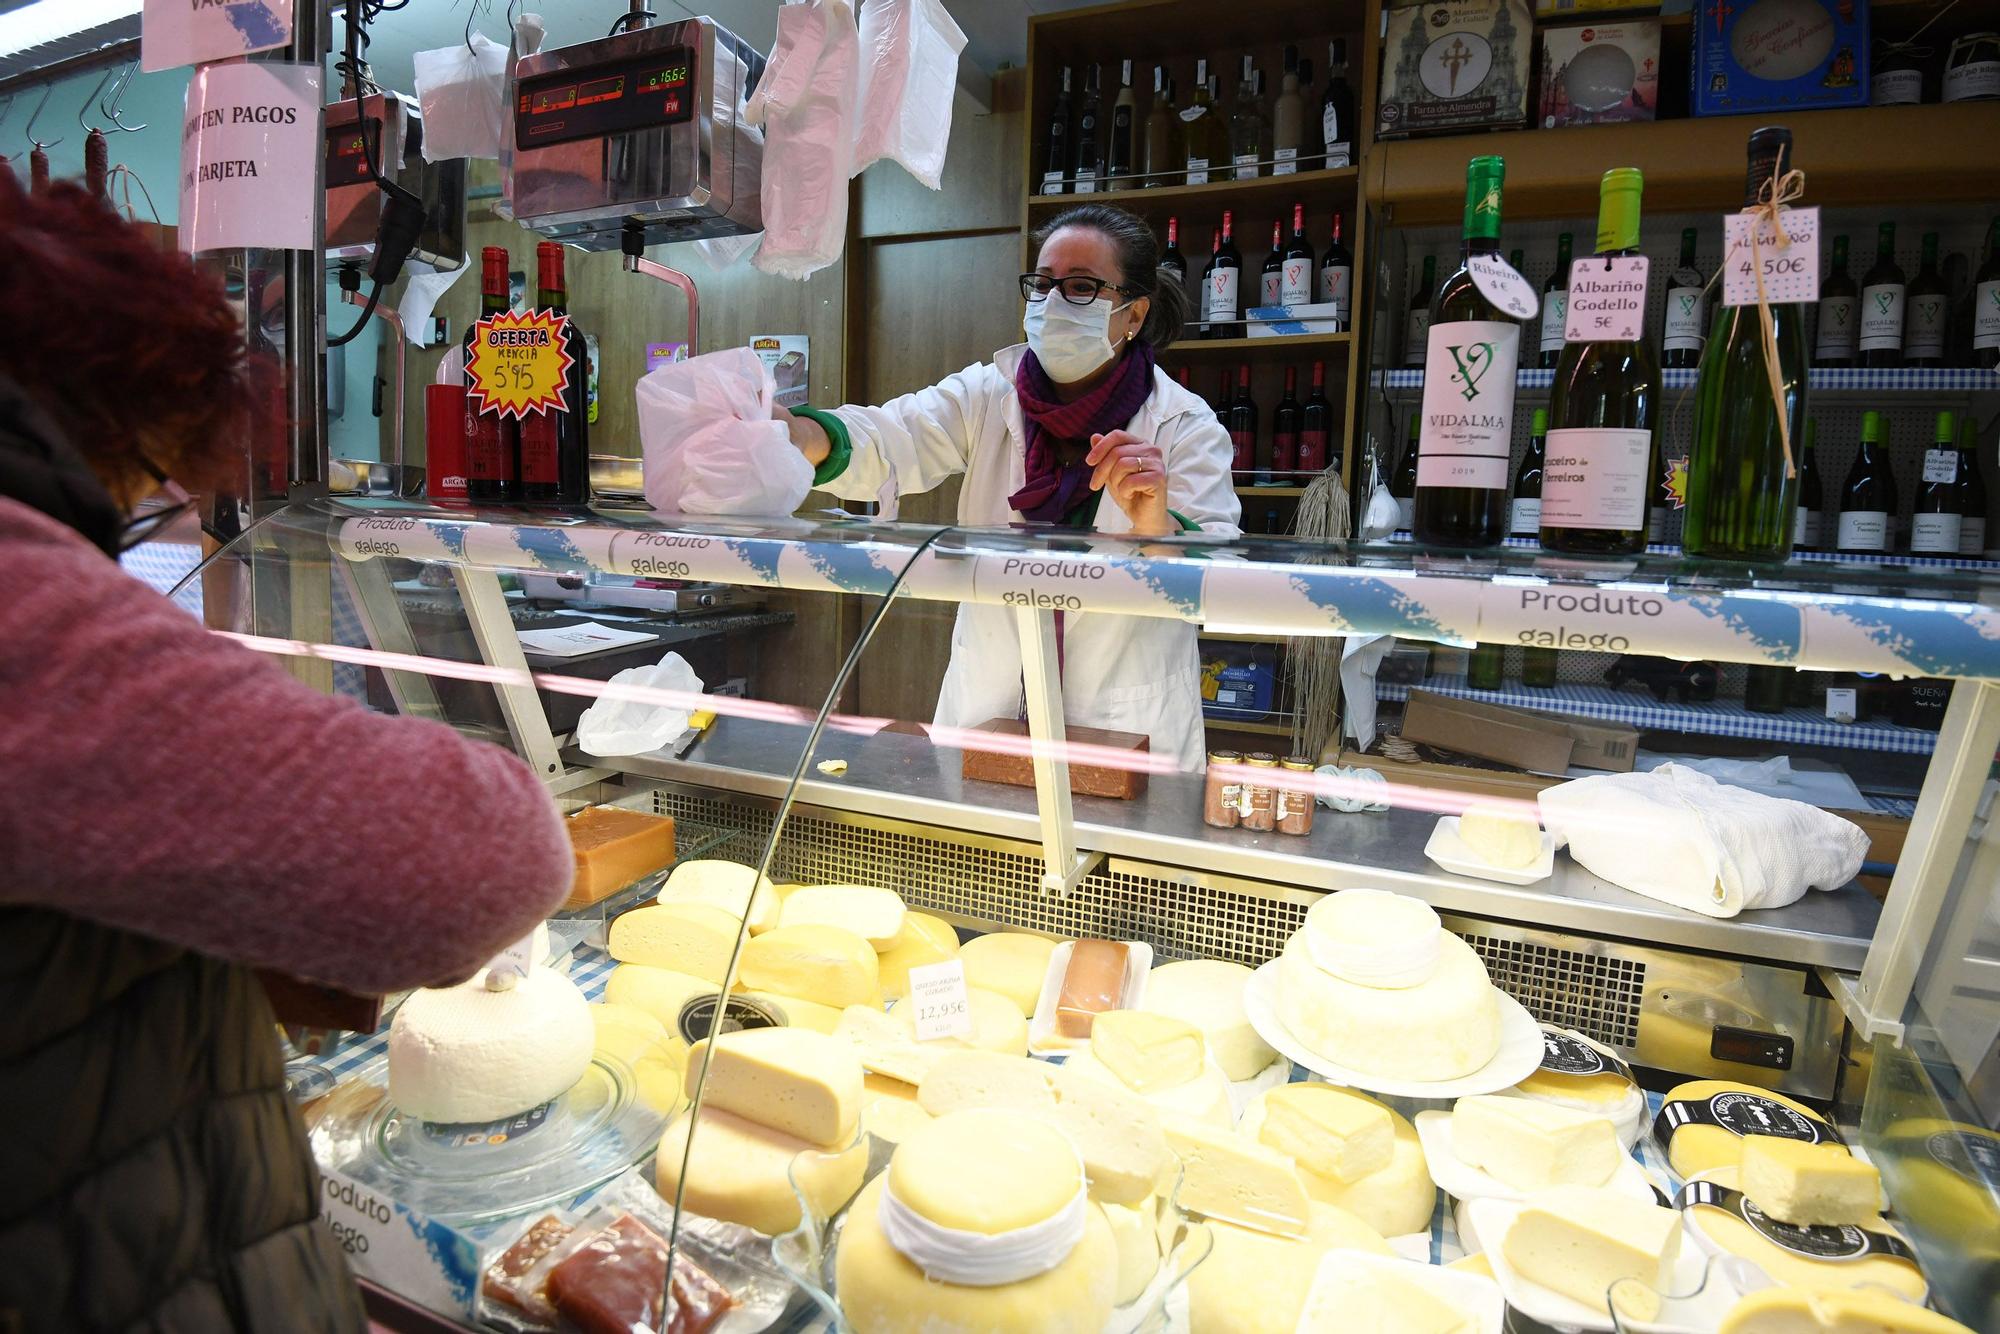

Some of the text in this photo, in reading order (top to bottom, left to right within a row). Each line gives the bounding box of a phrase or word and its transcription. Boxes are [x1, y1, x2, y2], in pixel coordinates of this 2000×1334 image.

[232, 106, 297, 125] PAGOS
[199, 160, 258, 184] TARJETA
[1473, 262, 1520, 281] Ribeiro
[1740, 257, 1806, 276] 450€
[1572, 279, 1644, 294] Albariño
[1574, 298, 1638, 311] Godello
[1594, 316, 1614, 329] 5€
[488, 329, 550, 347] OFERTA
[755, 340, 779, 348] ARGAL
[1430, 414, 1504, 428] VIDALMA
[356, 517, 415, 531] Produto
[354, 538, 400, 556] galego
[633, 532, 711, 549] Produto
[631, 555, 690, 578] galego
[1003, 558, 1105, 580] Produto
[1002, 588, 1082, 611] galego
[1521, 589, 1663, 617] Produto
[1518, 626, 1630, 652] galego
[919, 1000, 966, 1021] 12,95€
